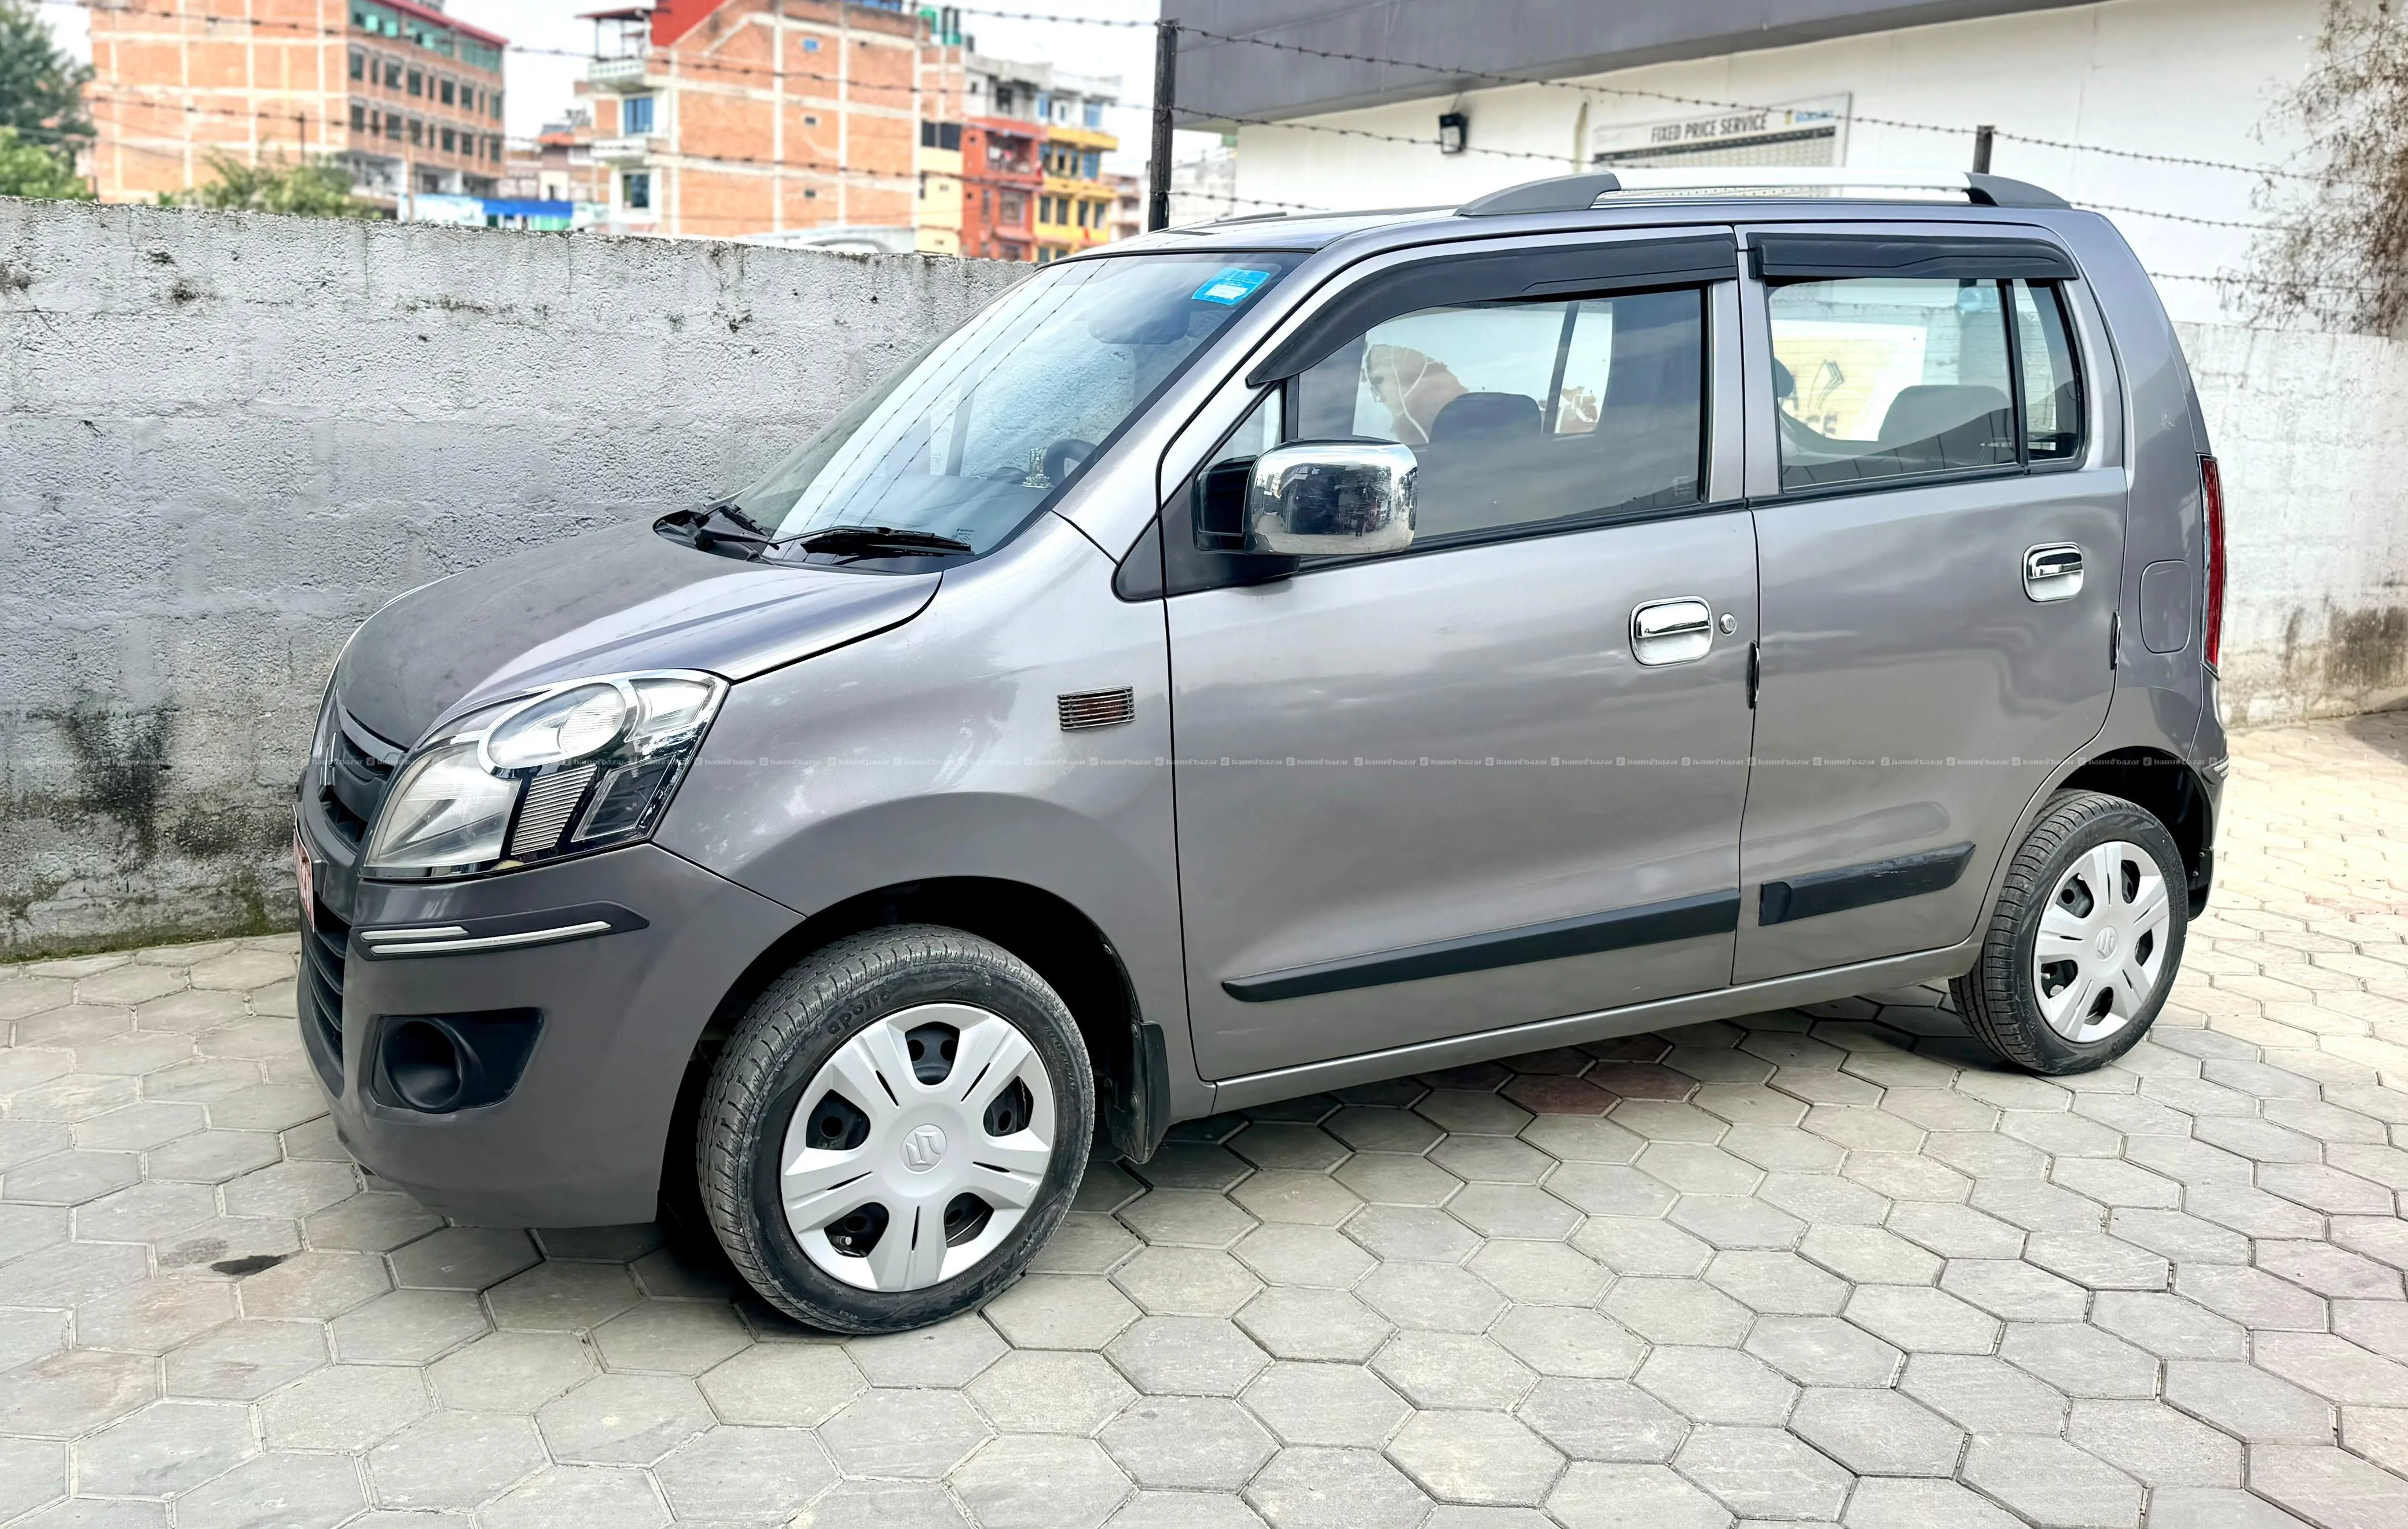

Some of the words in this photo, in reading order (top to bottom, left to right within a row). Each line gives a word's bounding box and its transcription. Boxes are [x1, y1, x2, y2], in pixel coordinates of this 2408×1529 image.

[1651, 123, 1682, 144] FIXED
[1684, 119, 1717, 140] PRICE
[1720, 112, 1768, 135] SERVICE
[827, 990, 891, 1035] apollo
